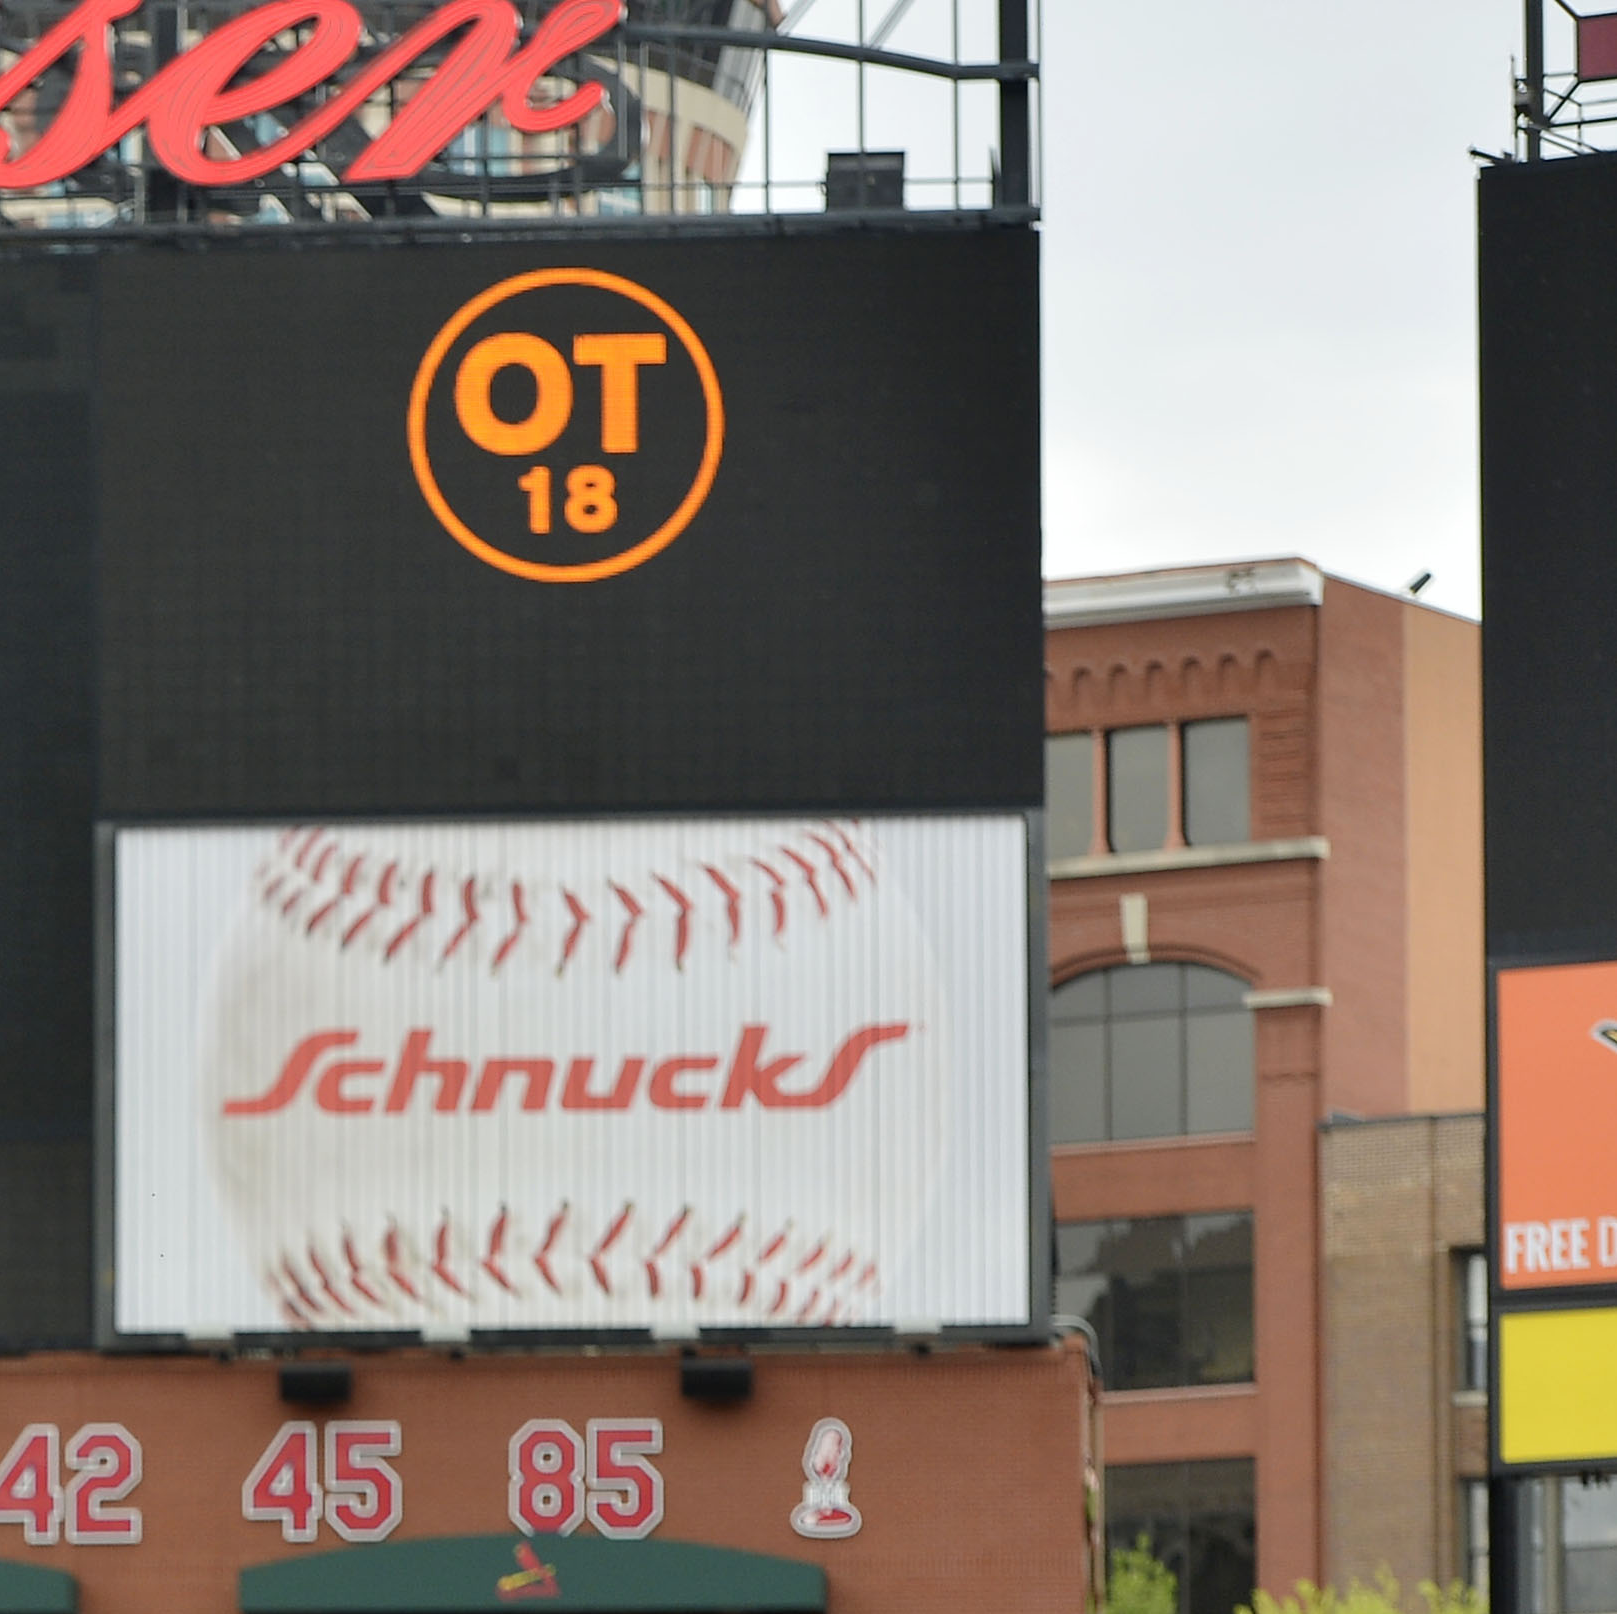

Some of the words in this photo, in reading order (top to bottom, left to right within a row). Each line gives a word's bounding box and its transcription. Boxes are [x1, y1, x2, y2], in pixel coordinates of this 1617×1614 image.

[453, 331, 667, 458] OT
[517, 466, 619, 535] 18
[222, 1022, 908, 1116] Schnucks
[1505, 1219, 1589, 1274] FREE
[242, 1420, 402, 1542] 45
[508, 1418, 663, 1540] 85
